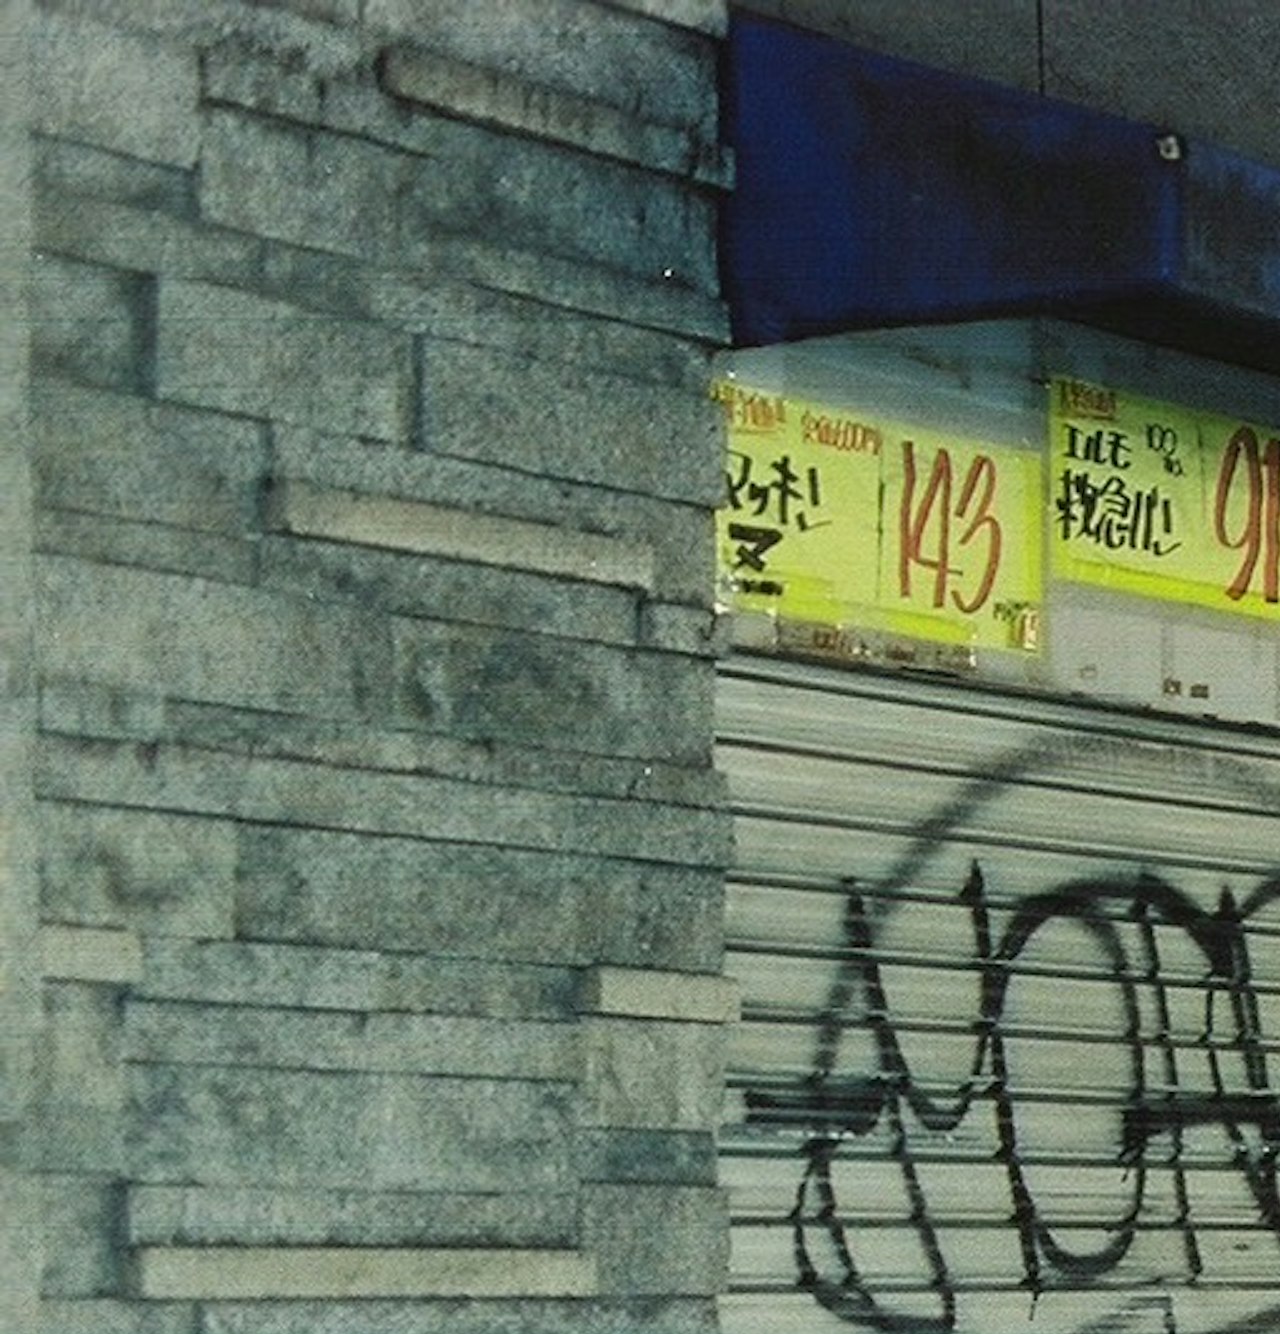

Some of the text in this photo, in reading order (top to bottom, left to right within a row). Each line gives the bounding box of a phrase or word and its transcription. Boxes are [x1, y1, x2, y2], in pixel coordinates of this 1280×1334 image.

[1063, 422, 1132, 470] エルモ
[897, 440, 1003, 615] 143
